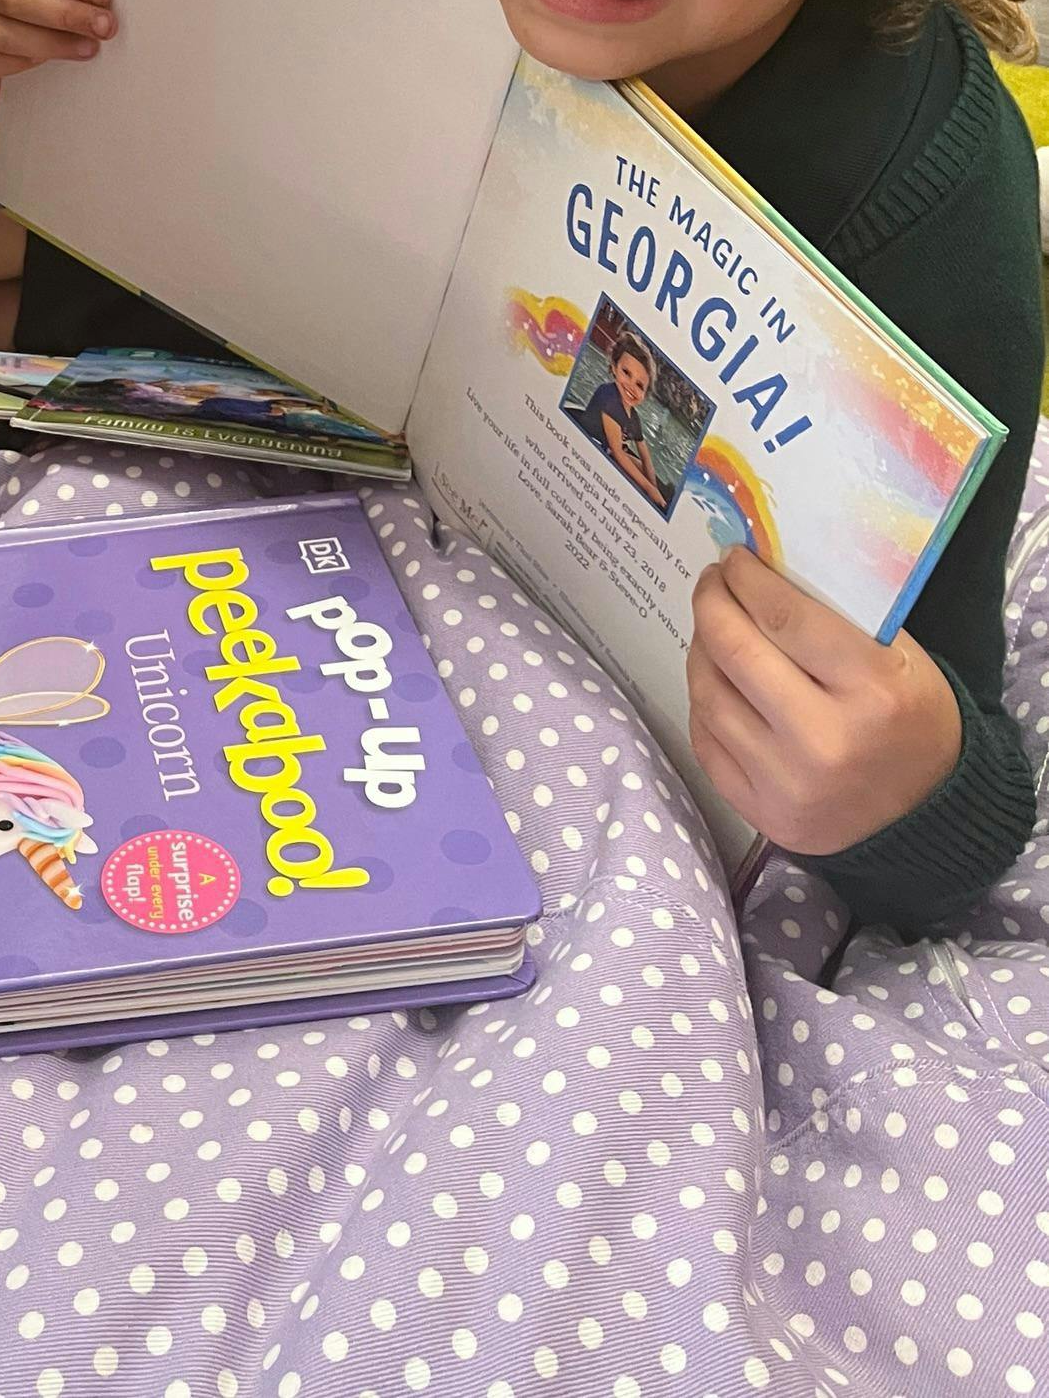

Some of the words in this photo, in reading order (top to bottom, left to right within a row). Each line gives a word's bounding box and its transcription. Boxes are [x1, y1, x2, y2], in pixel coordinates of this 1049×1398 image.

[615, 154, 660, 208] THE
[669, 194, 759, 296] MAGIC
[759, 296, 796, 344] IN
[566, 183, 813, 454] GEORGIA!
[84, 415, 164, 432] Family
[204, 429, 343, 459] Everything
[525, 394, 544, 421] This
[546, 420, 569, 448] book
[572, 448, 591, 472] was
[593, 472, 620, 502] made
[622, 503, 673, 560] especially
[675, 559, 691, 579] for
[309, 541, 340, 568] DK
[467, 387, 482, 412] Live
[483, 412, 503, 437] your
[504, 436, 519, 457] life
[521, 455, 530, 470] in
[532, 468, 550, 490] full
[551, 490, 576, 517] color
[577, 517, 590, 534] by
[591, 532, 619, 568] being
[614, 566, 656, 610] exactly
[658, 609, 679, 638] who
[518, 470, 542, 502] Love,
[546, 500, 572, 534] Sarah
[576, 533, 599, 560] Bear
[608, 571, 653, 618] Steve-O
[526, 435, 545, 460] who
[547, 461, 583, 501] arrived
[585, 501, 597, 516] on
[599, 516, 622, 543] July
[623, 542, 637, 562] 23,
[641, 561, 666, 592] 2018
[562, 456, 599, 500] Georgia
[602, 498, 638, 539] Lauber
[565, 540, 589, 570] 2022
[125, 629, 201, 801] Unicorn
[150, 547, 370, 897] peekaboo!
[285, 595, 426, 809] pop-up
[123, 864, 146, 903] flap!
[148, 846, 162, 878] under
[149, 882, 165, 920] every
[171, 841, 195, 922] surprise
[199, 873, 216, 886] A
